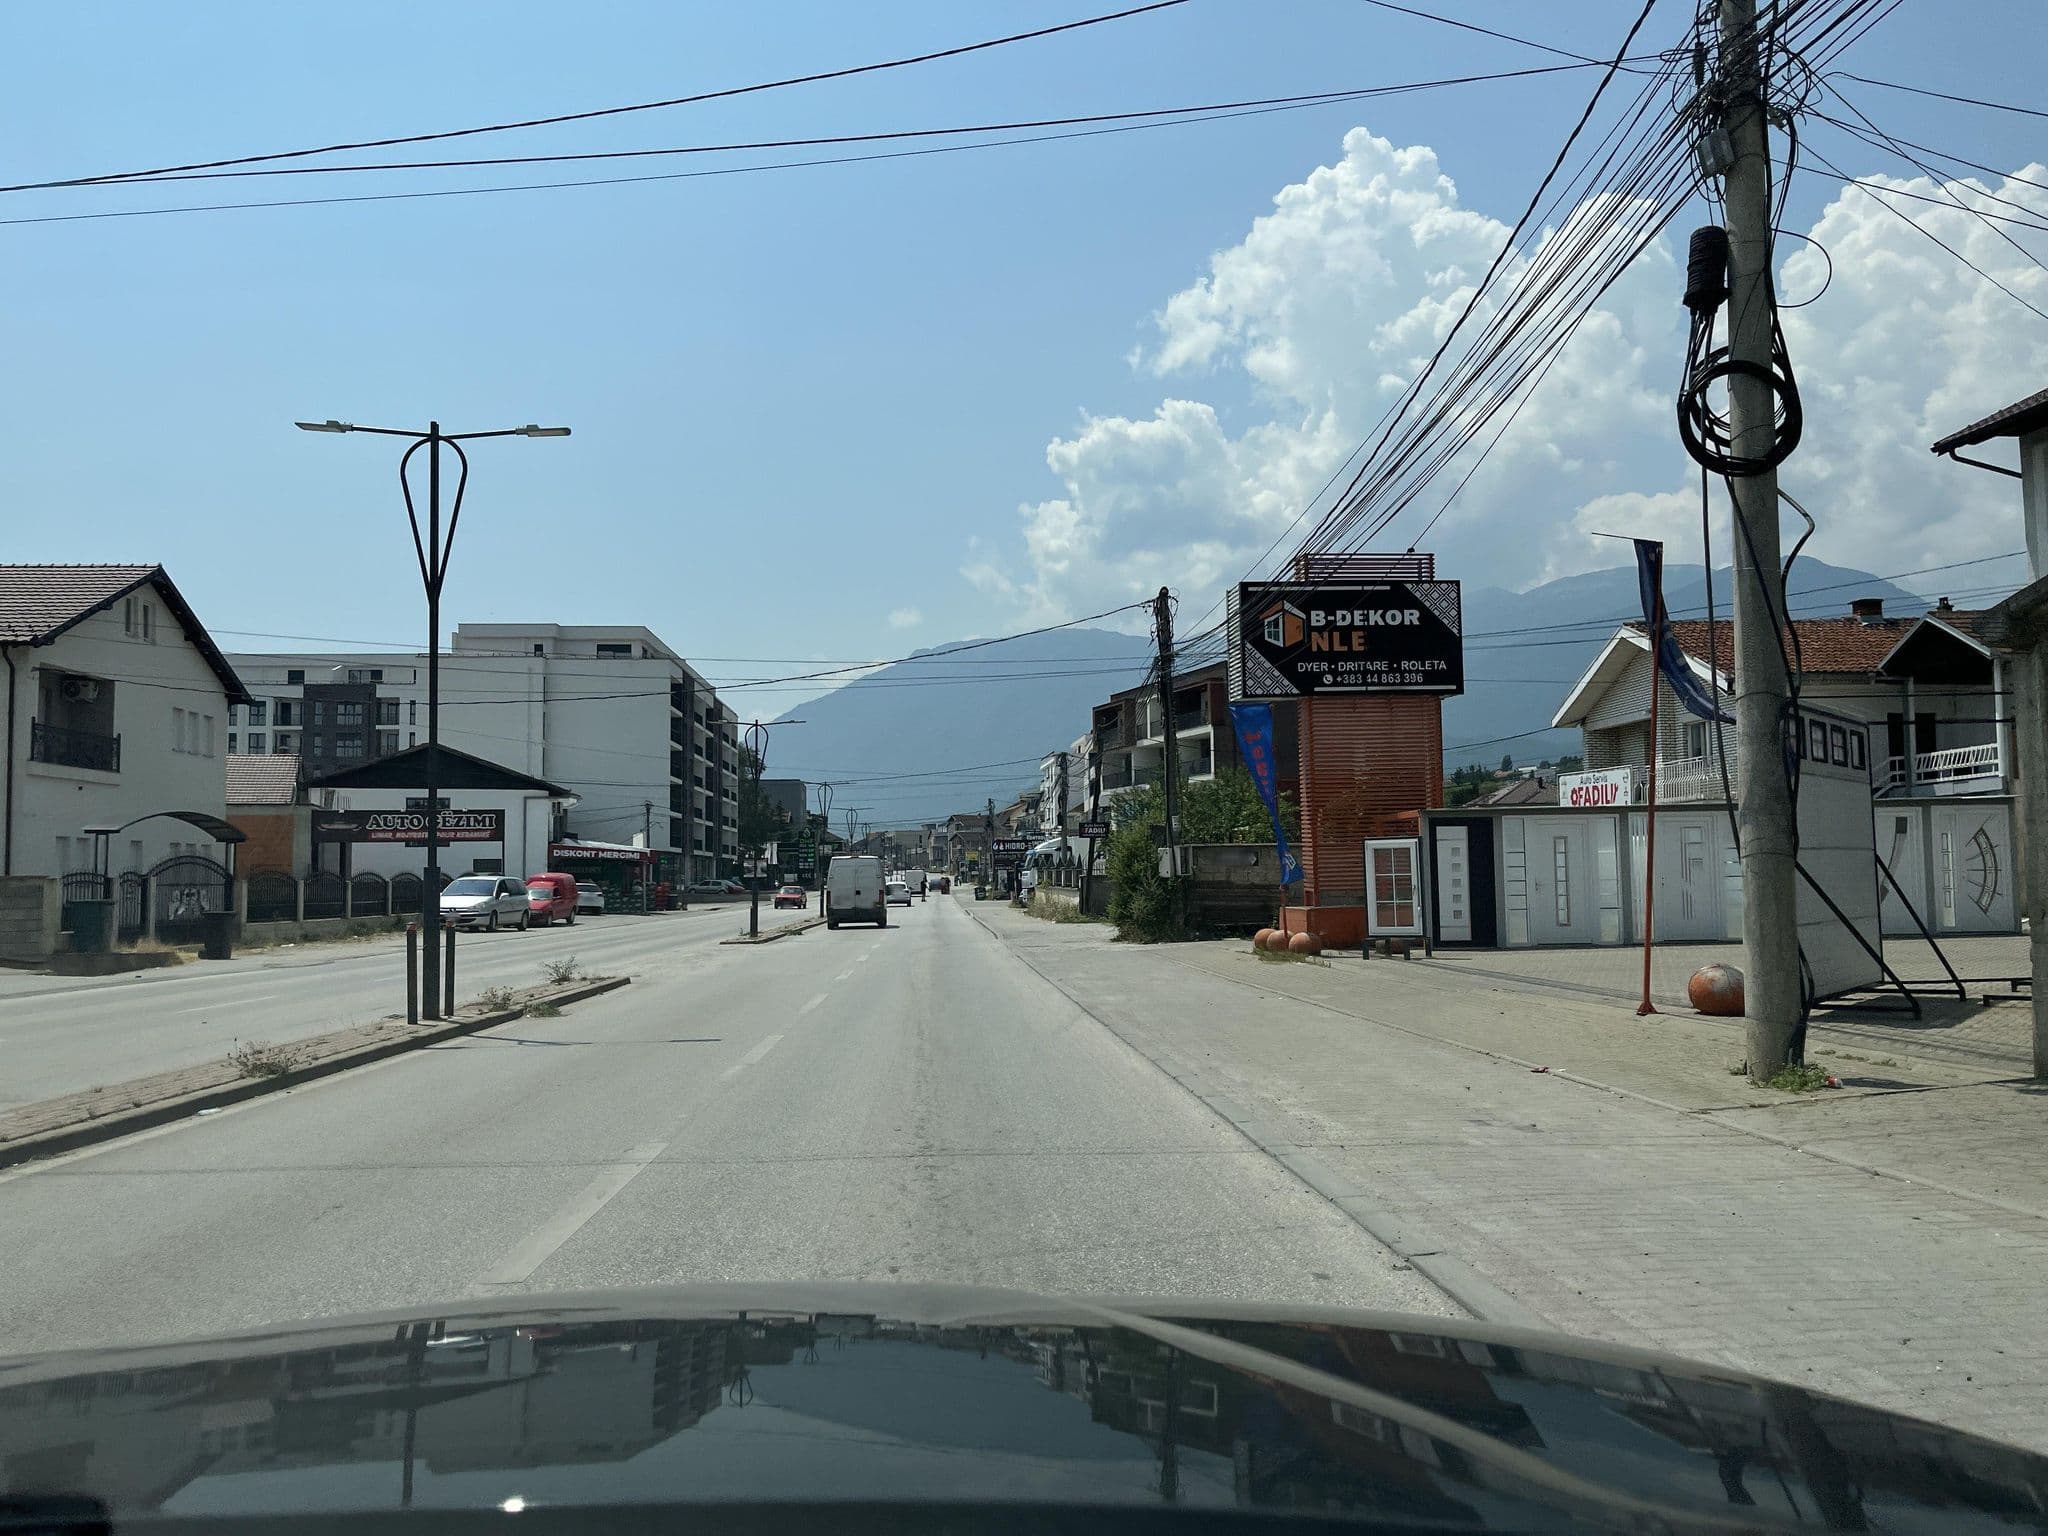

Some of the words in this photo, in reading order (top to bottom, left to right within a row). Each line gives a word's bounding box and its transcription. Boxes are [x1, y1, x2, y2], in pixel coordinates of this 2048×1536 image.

[1310, 609, 1420, 626] B-DEKOR
[1311, 631, 1366, 651] NLE
[1297, 662, 1329, 672] DYER
[1338, 661, 1389, 671] DRITARE
[1401, 660, 1447, 670] ROLETA
[1336, 674, 1362, 684] +383
[1381, 673, 1401, 683] 863
[1404, 672, 1424, 682] 396
[366, 814, 424, 829] AUTO
[553, 849, 597, 858] DISKONT
[598, 851, 640, 859] MERGIMI
